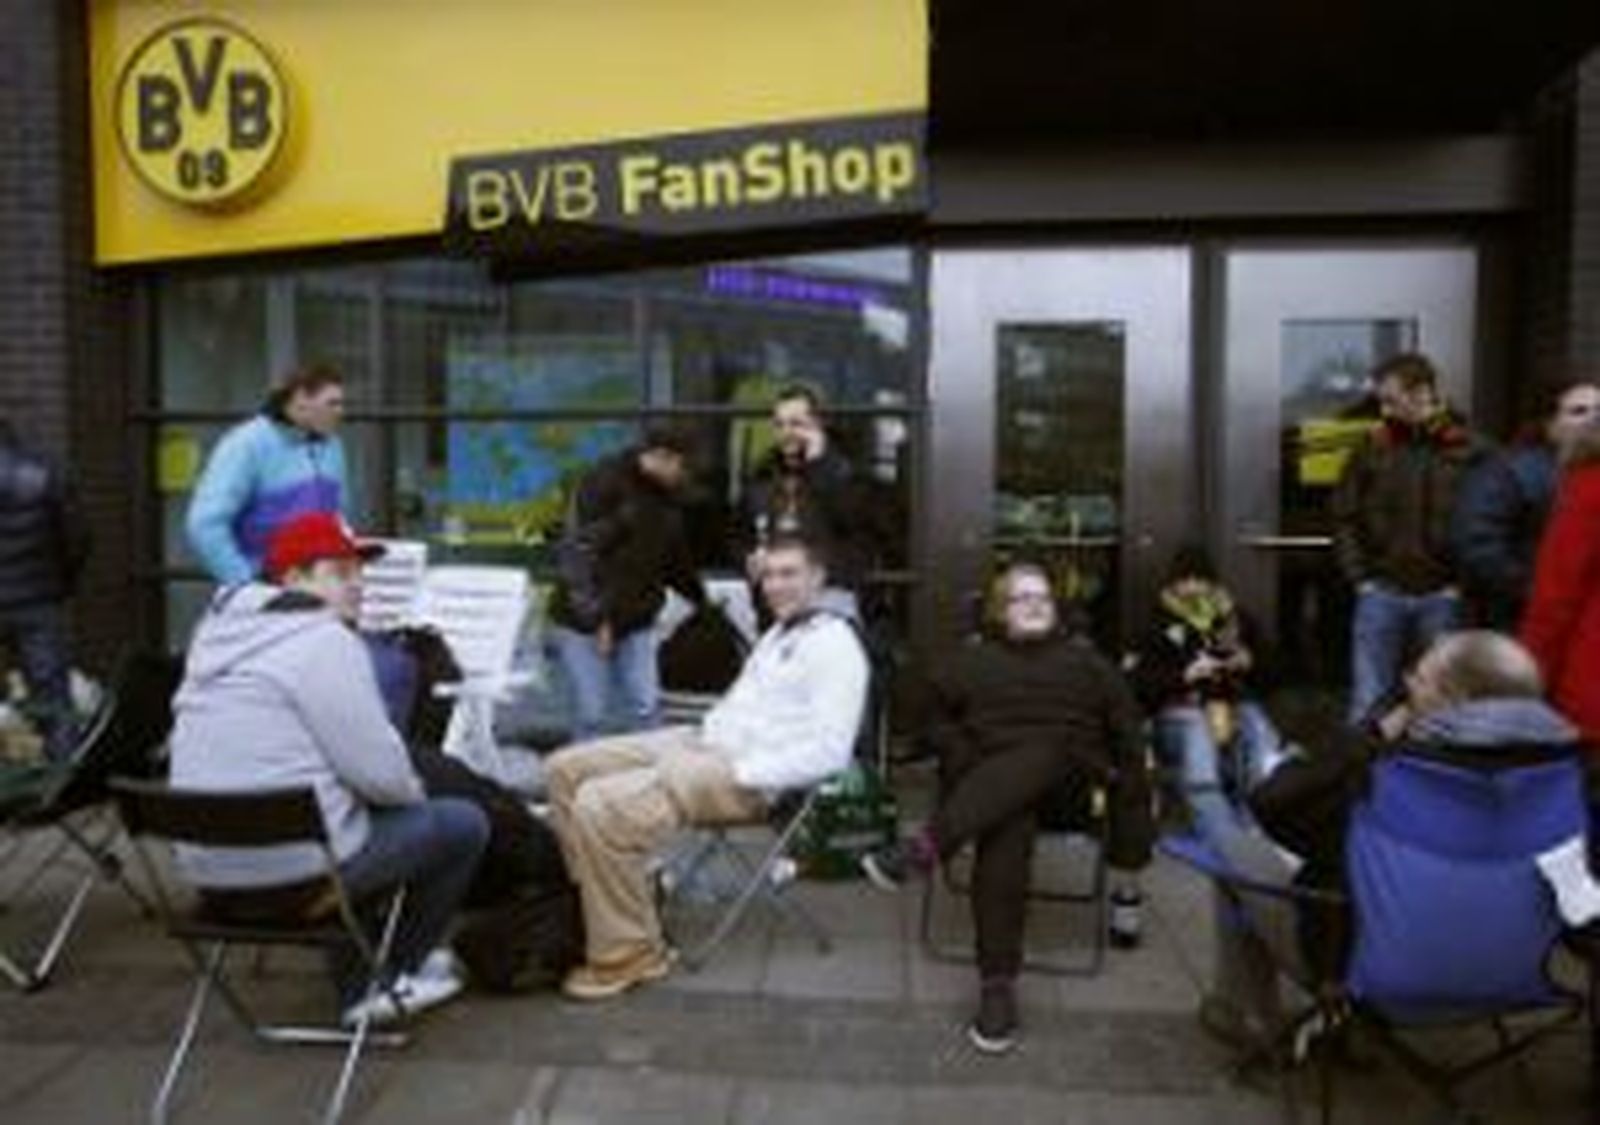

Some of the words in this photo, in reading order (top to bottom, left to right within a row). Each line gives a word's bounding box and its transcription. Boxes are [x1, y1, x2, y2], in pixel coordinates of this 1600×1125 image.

[137, 36, 273, 153] BVB
[466, 161, 599, 231] BVB
[618, 140, 914, 215] FanShop
